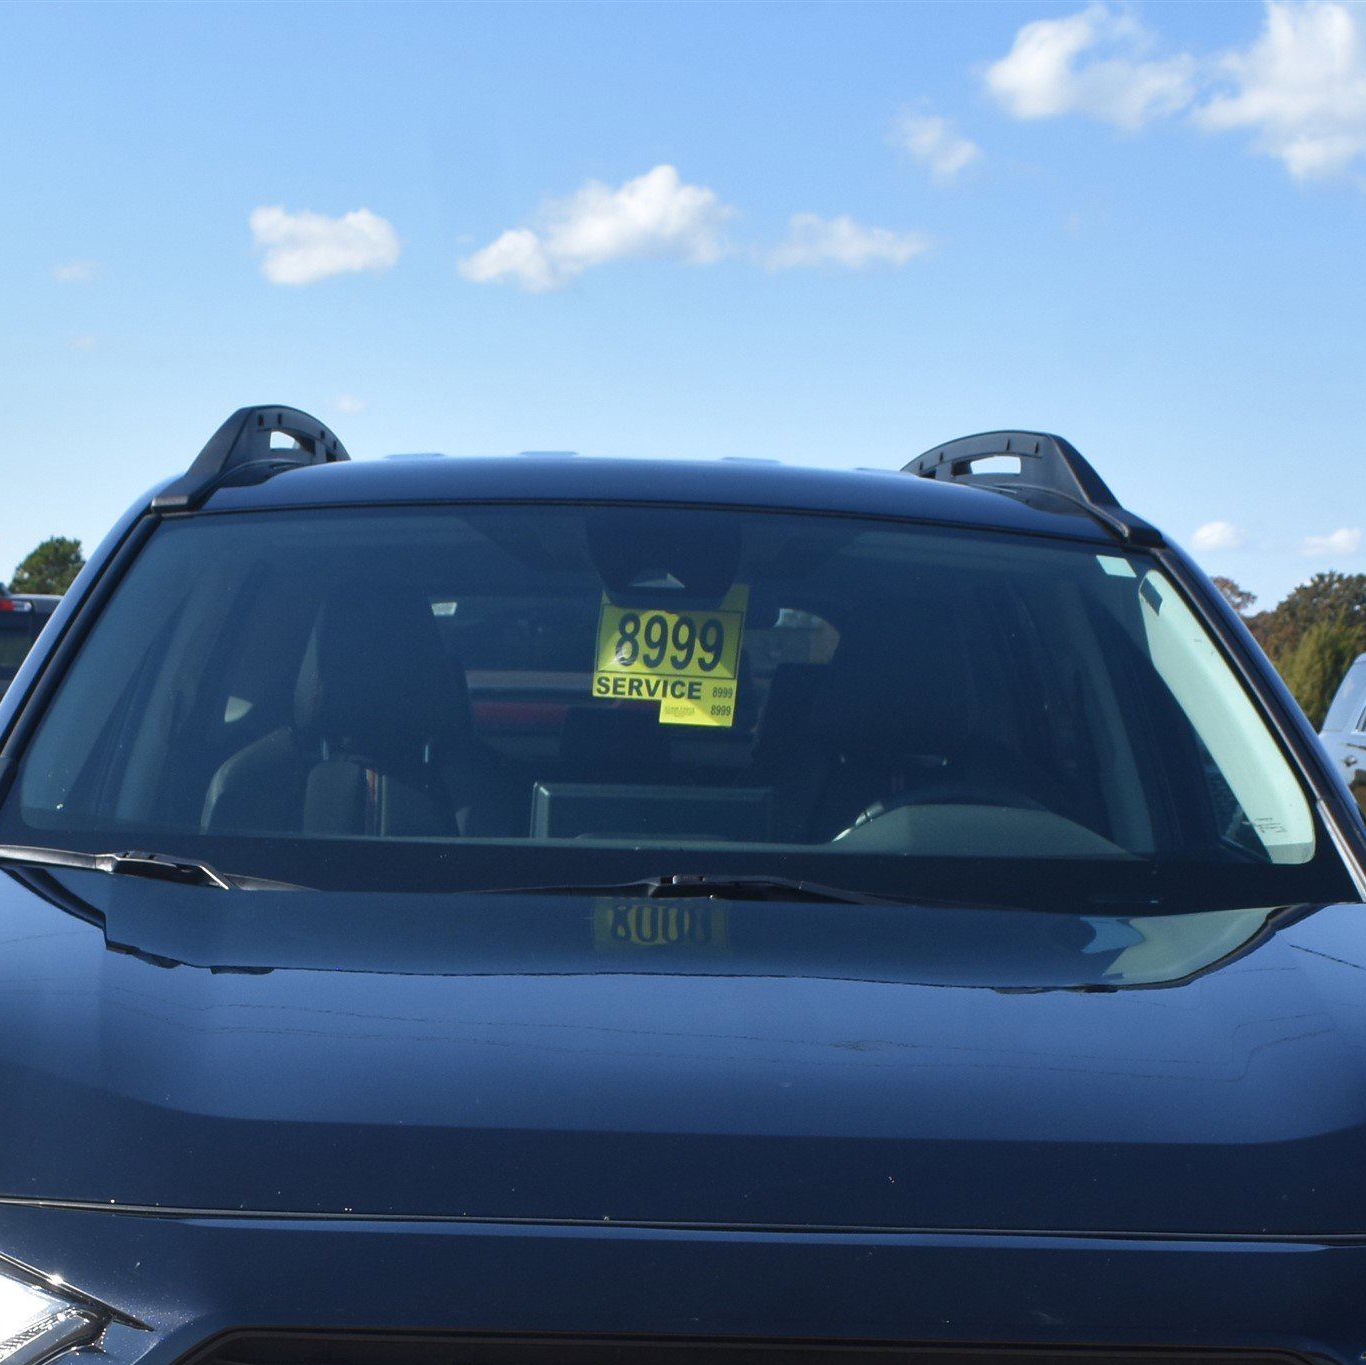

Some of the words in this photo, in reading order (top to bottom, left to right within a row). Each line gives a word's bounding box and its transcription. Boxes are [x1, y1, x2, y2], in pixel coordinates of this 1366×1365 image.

[615, 613, 724, 672] 8999
[596, 676, 702, 700] SERVICE
[712, 686, 733, 699] 8999
[710, 704, 731, 716] 8999
